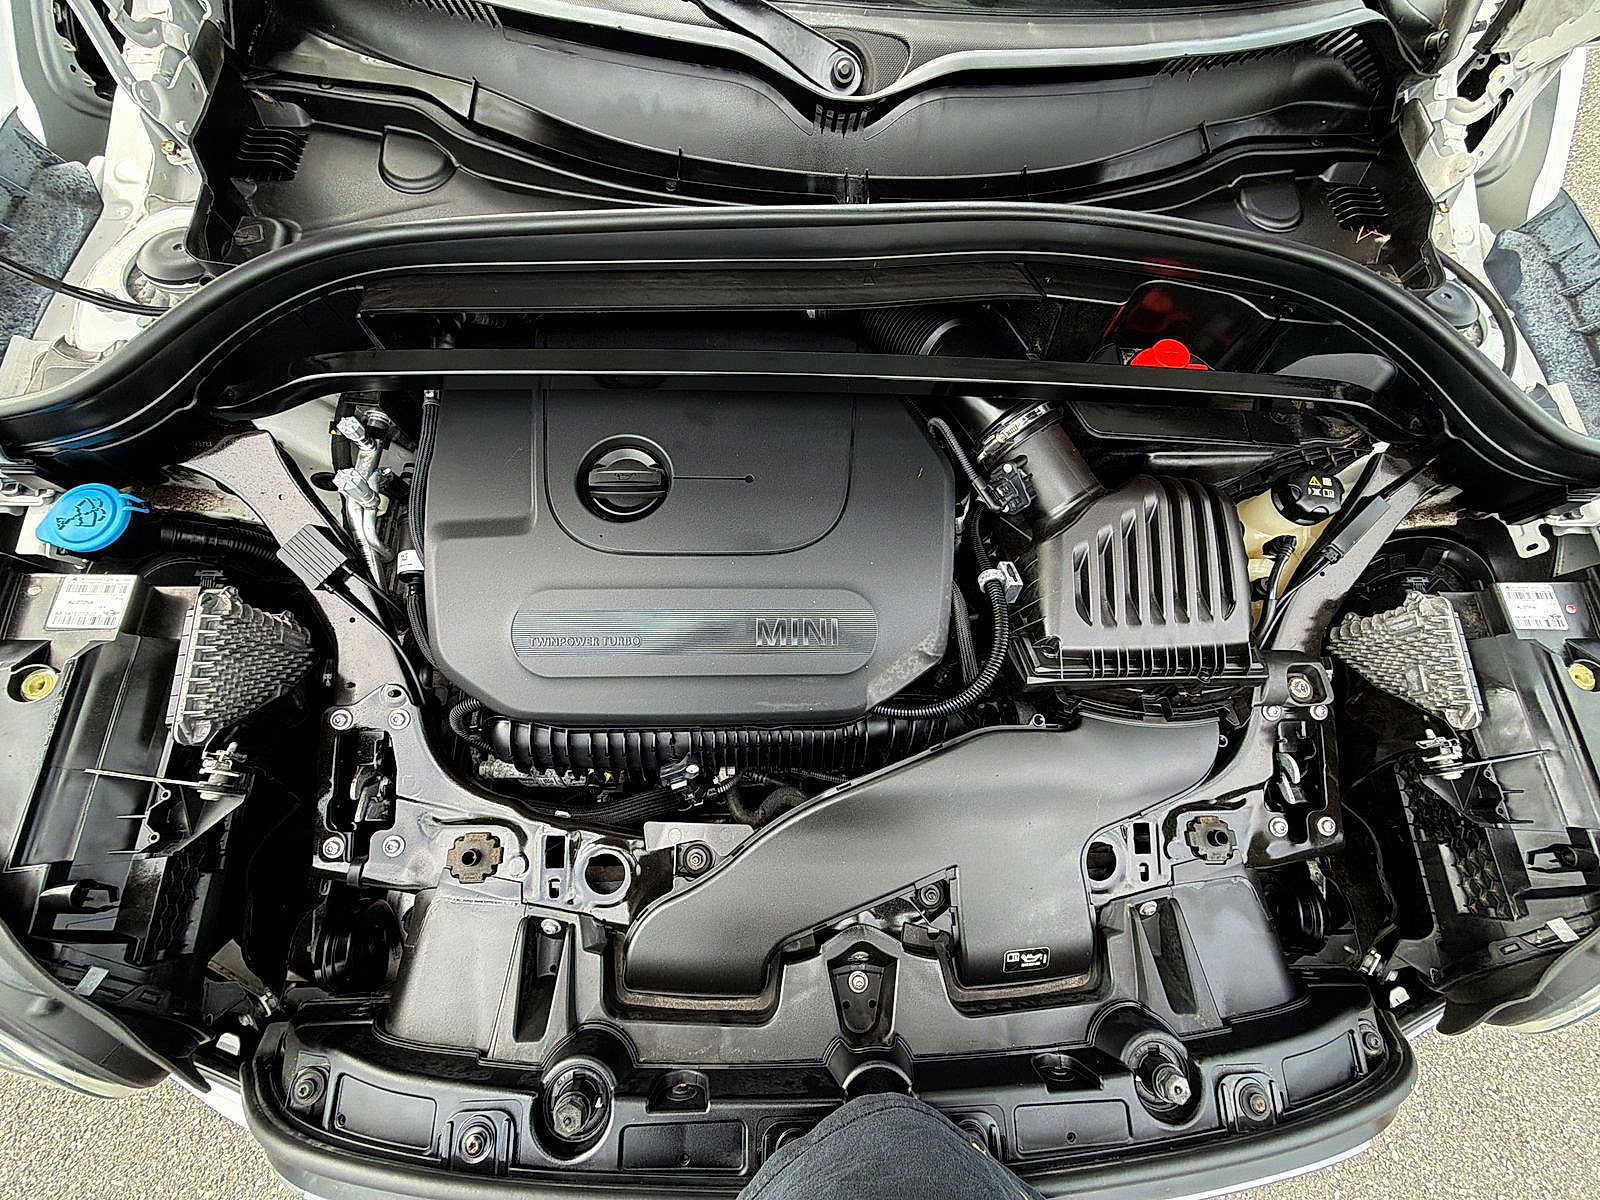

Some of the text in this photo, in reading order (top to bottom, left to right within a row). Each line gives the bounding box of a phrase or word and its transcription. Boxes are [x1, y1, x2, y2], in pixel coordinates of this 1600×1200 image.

[529, 635, 642, 648] TWINPOWER TURBO
[755, 617, 839, 647] MINI
